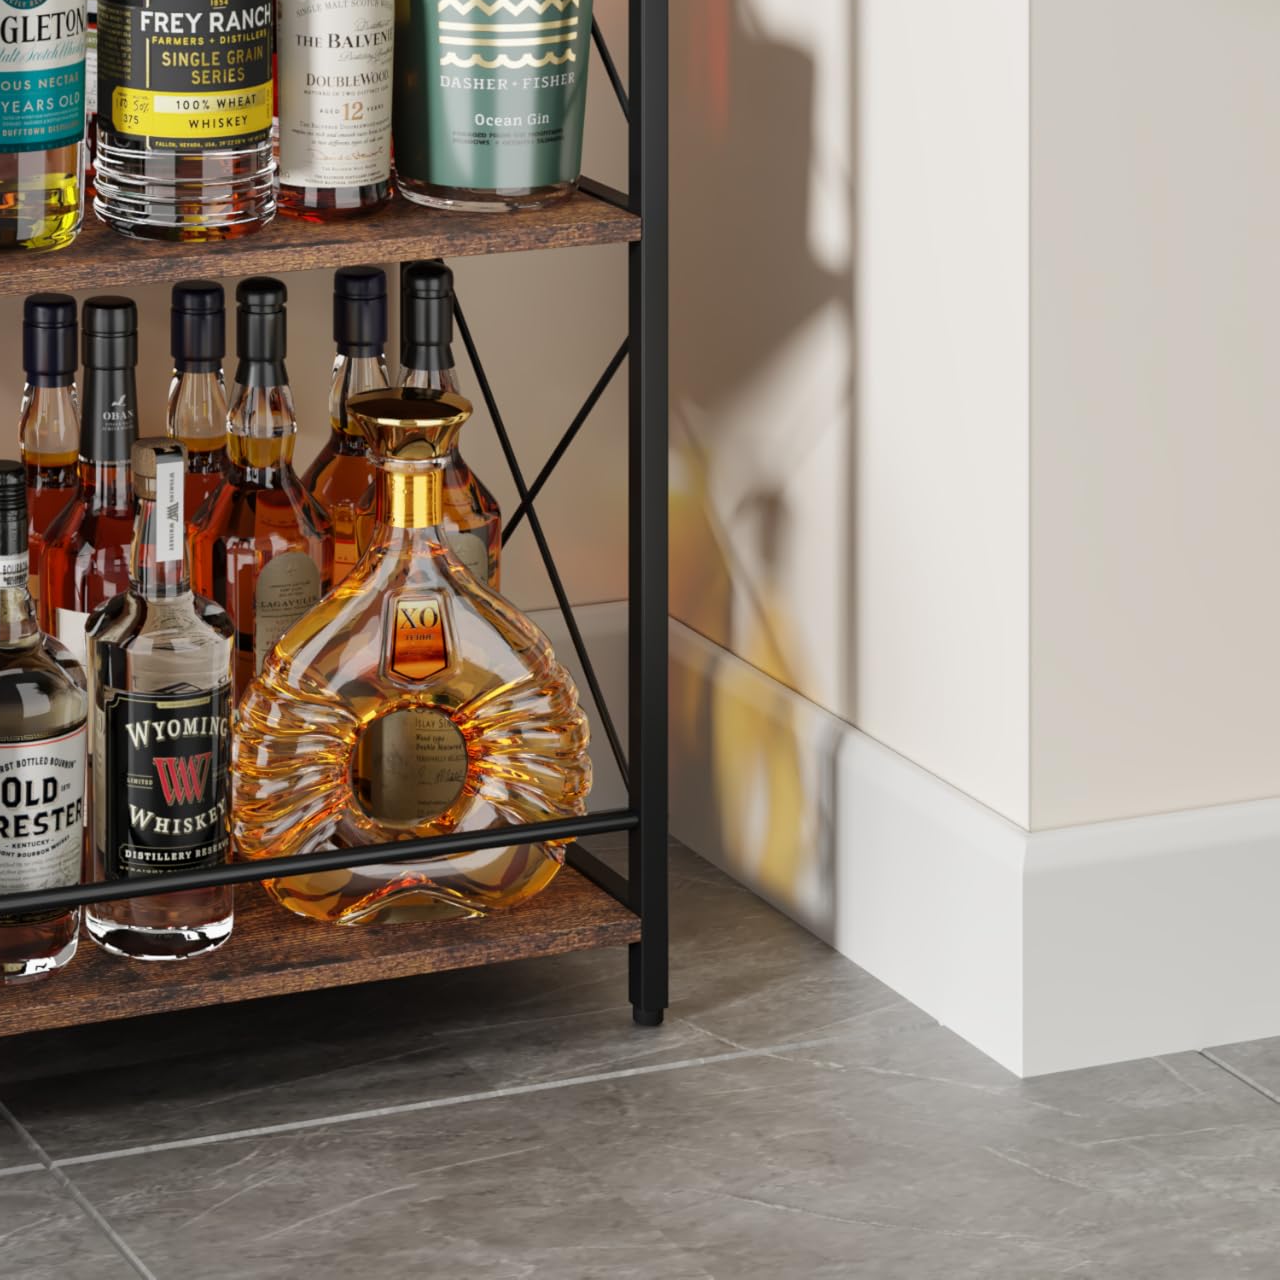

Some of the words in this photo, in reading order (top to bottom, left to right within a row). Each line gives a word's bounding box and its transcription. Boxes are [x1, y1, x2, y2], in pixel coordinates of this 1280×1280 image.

[296, 4, 322, 17] SINGLE
[324, 0, 348, 10] MALT
[140, 11, 203, 34] FREY
[209, 2, 271, 33] RANCH
[152, 35, 205, 46] FARMERS
[296, 33, 322, 48] THE
[162, 51, 220, 67] SINGLE
[227, 45, 263, 65] GRAIN
[191, 67, 245, 85] SERIES
[440, 75, 508, 91] DASHER
[523, 71, 575, 90] FISHER
[1, 97, 54, 113] YEARS
[59, 91, 80, 108] OLD
[176, 100, 210, 110] 100%
[217, 93, 257, 109] WHEAT
[342, 101, 364, 121] 12
[189, 114, 248, 129] WHISKEY
[475, 113, 522, 127] Ocean
[527, 113, 550, 126] Gin
[103, 409, 134, 420] OBAN
[400, 607, 438, 629] XO
[125, 717, 228, 750] WYOMING
[16, 756, 49, 769] BOTTLED
[1, 776, 58, 808] OLD
[128, 798, 226, 835] WHISKEY
[12, 839, 50, 849] KENTUCKY
[17, 847, 50, 858] BOURBON
[125, 849, 192, 862] DISTILLERY
